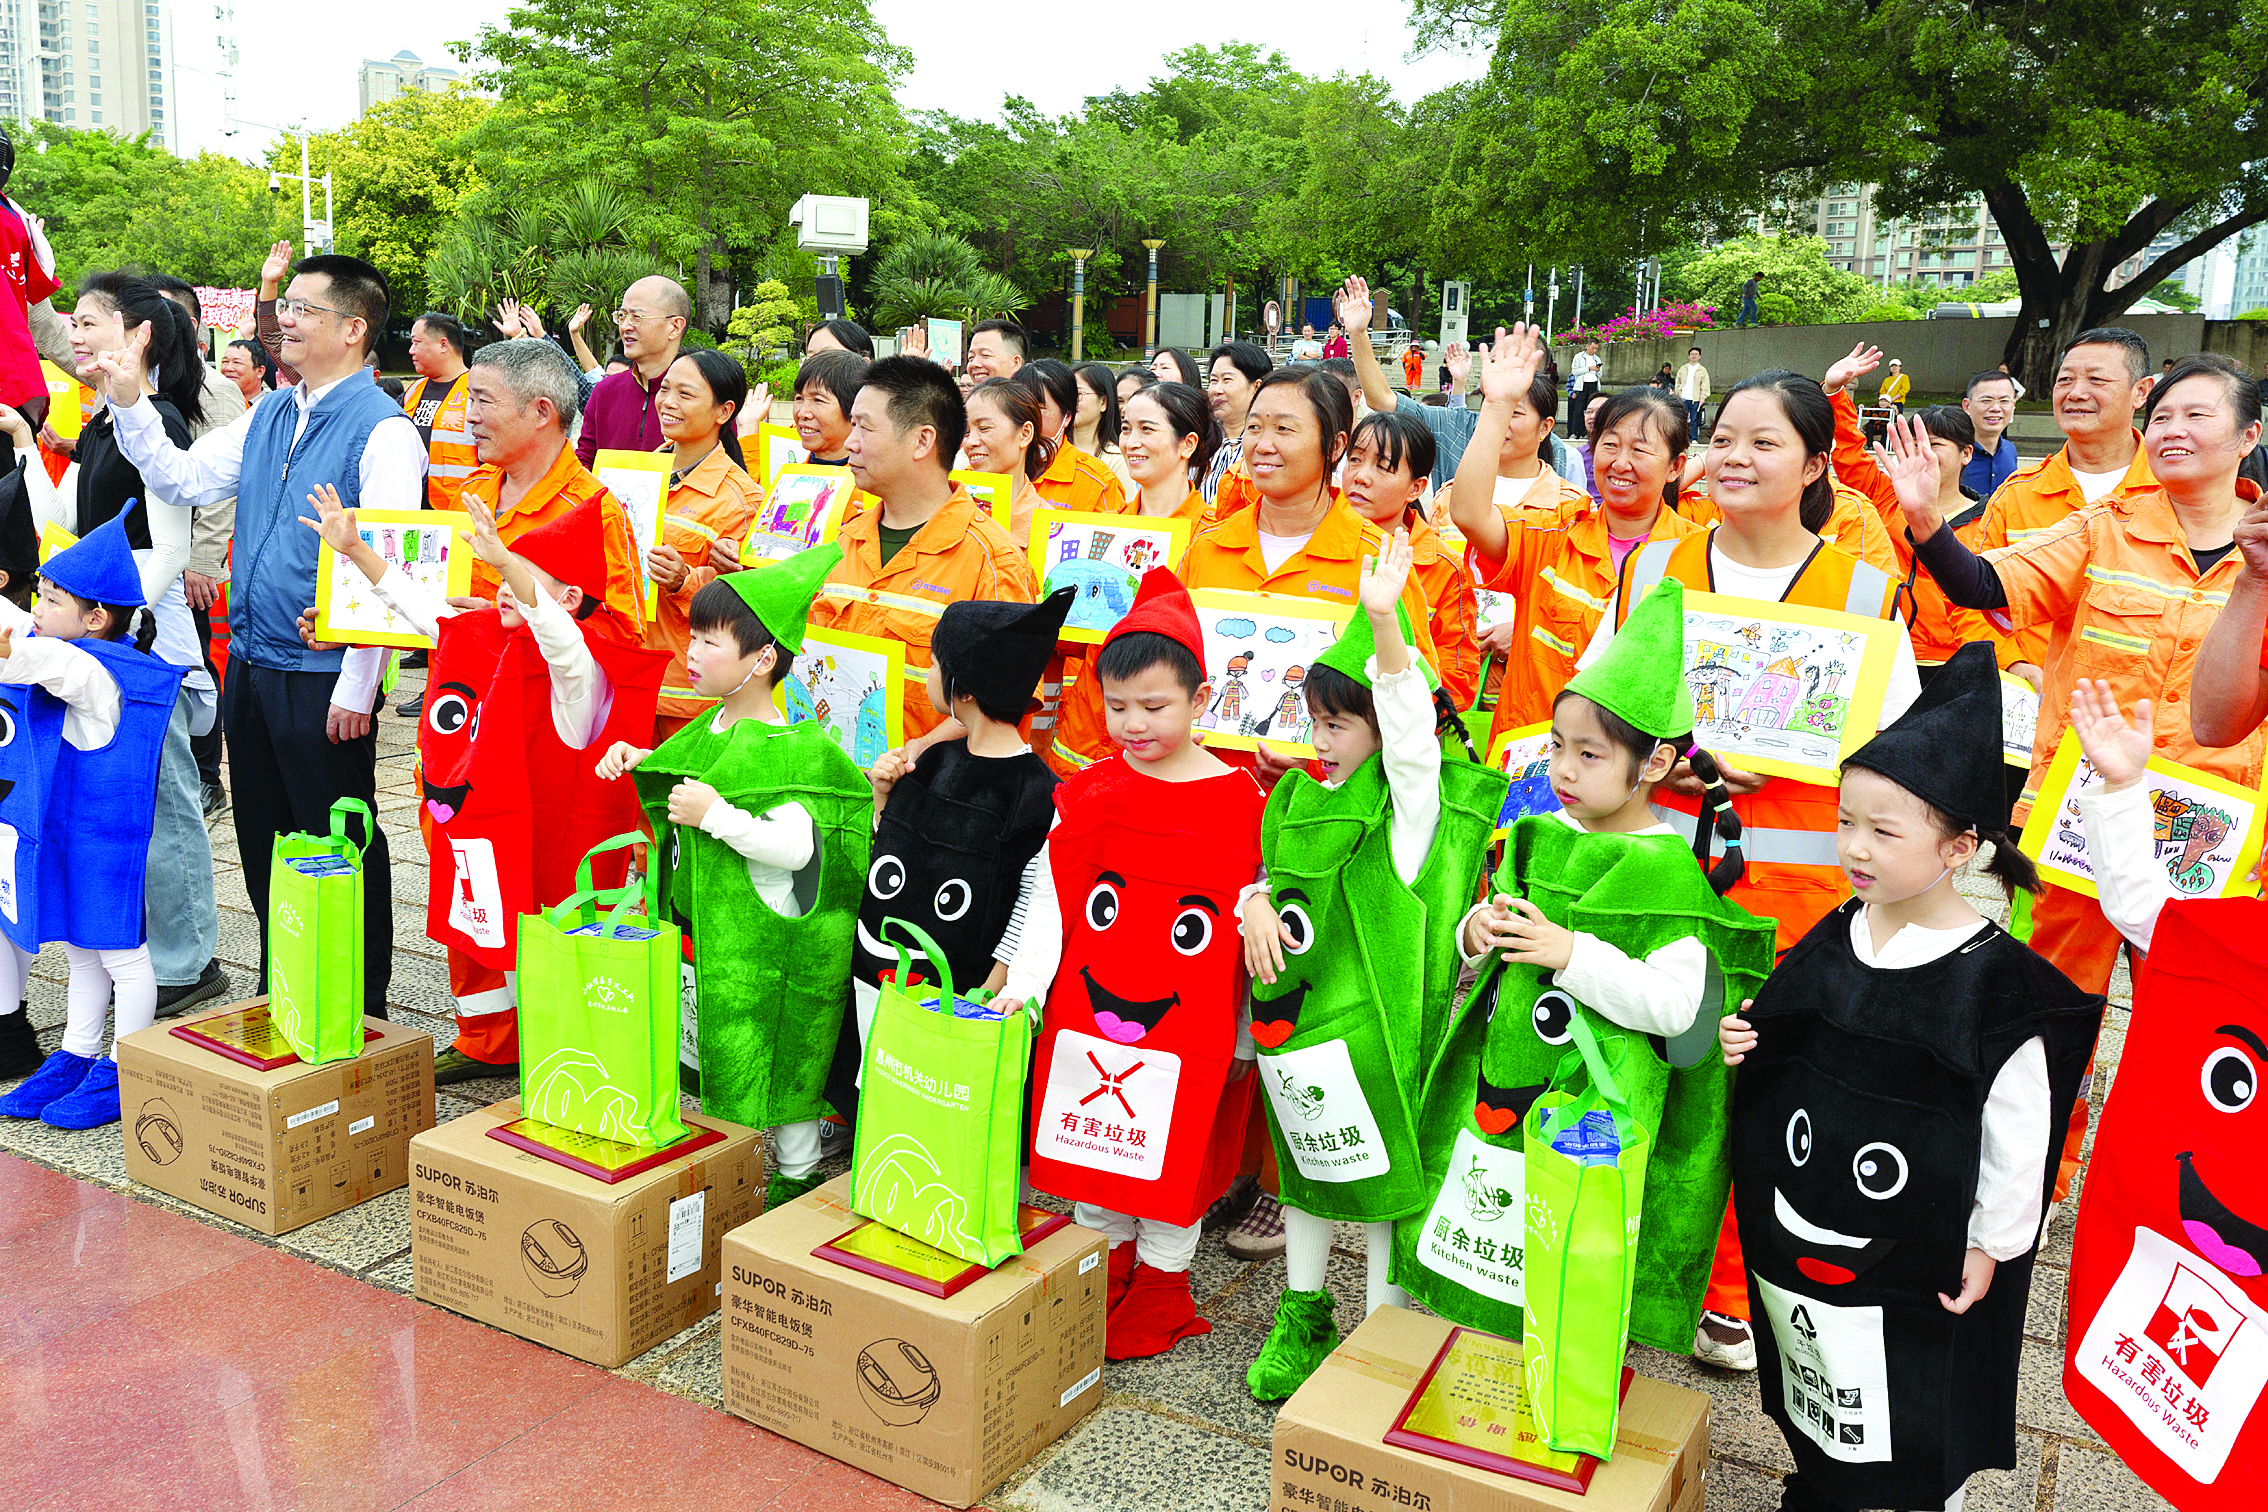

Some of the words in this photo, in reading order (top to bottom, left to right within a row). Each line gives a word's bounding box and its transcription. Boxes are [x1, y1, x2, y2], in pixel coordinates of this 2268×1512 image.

[875, 1047, 970, 1102] 惠州市机关幼儿园
[921, 1093, 970, 1112] KINDERGARTEN
[1055, 1133, 1110, 1154] Hazardous
[1113, 1147, 1145, 1162] Waste
[1060, 1111, 1147, 1148] 有害垃圾
[1290, 1125, 1366, 1153] 厨余垃圾
[210, 1158, 265, 1190] 豪华智能电饭煲
[1300, 1154, 1331, 1168] Kitchen
[1331, 1151, 1370, 1168] waste
[199, 1176, 226, 1199] 苏泊尔
[229, 1187, 266, 1215] SUPOR
[415, 1162, 461, 1192] SUPOR
[464, 1179, 499, 1205] 苏泊尔
[415, 1188, 485, 1226] 豪华智能电饭煲
[1433, 1215, 1524, 1272] 厨余垃圾
[1430, 1241, 1473, 1272] Kitchen
[1476, 1267, 1520, 1288] waste
[731, 1264, 786, 1300] SUPOR
[790, 1287, 832, 1317] 苏泊尔
[730, 1292, 813, 1339] 豪华智能电饭煲
[2101, 1355, 2161, 1413] Hazardous
[2162, 1409, 2199, 1449] Waste
[2114, 1332, 2210, 1433] 有害垃圾
[1284, 1448, 1365, 1490] SUPOR
[1370, 1477, 1432, 1512] 苏泊尔
